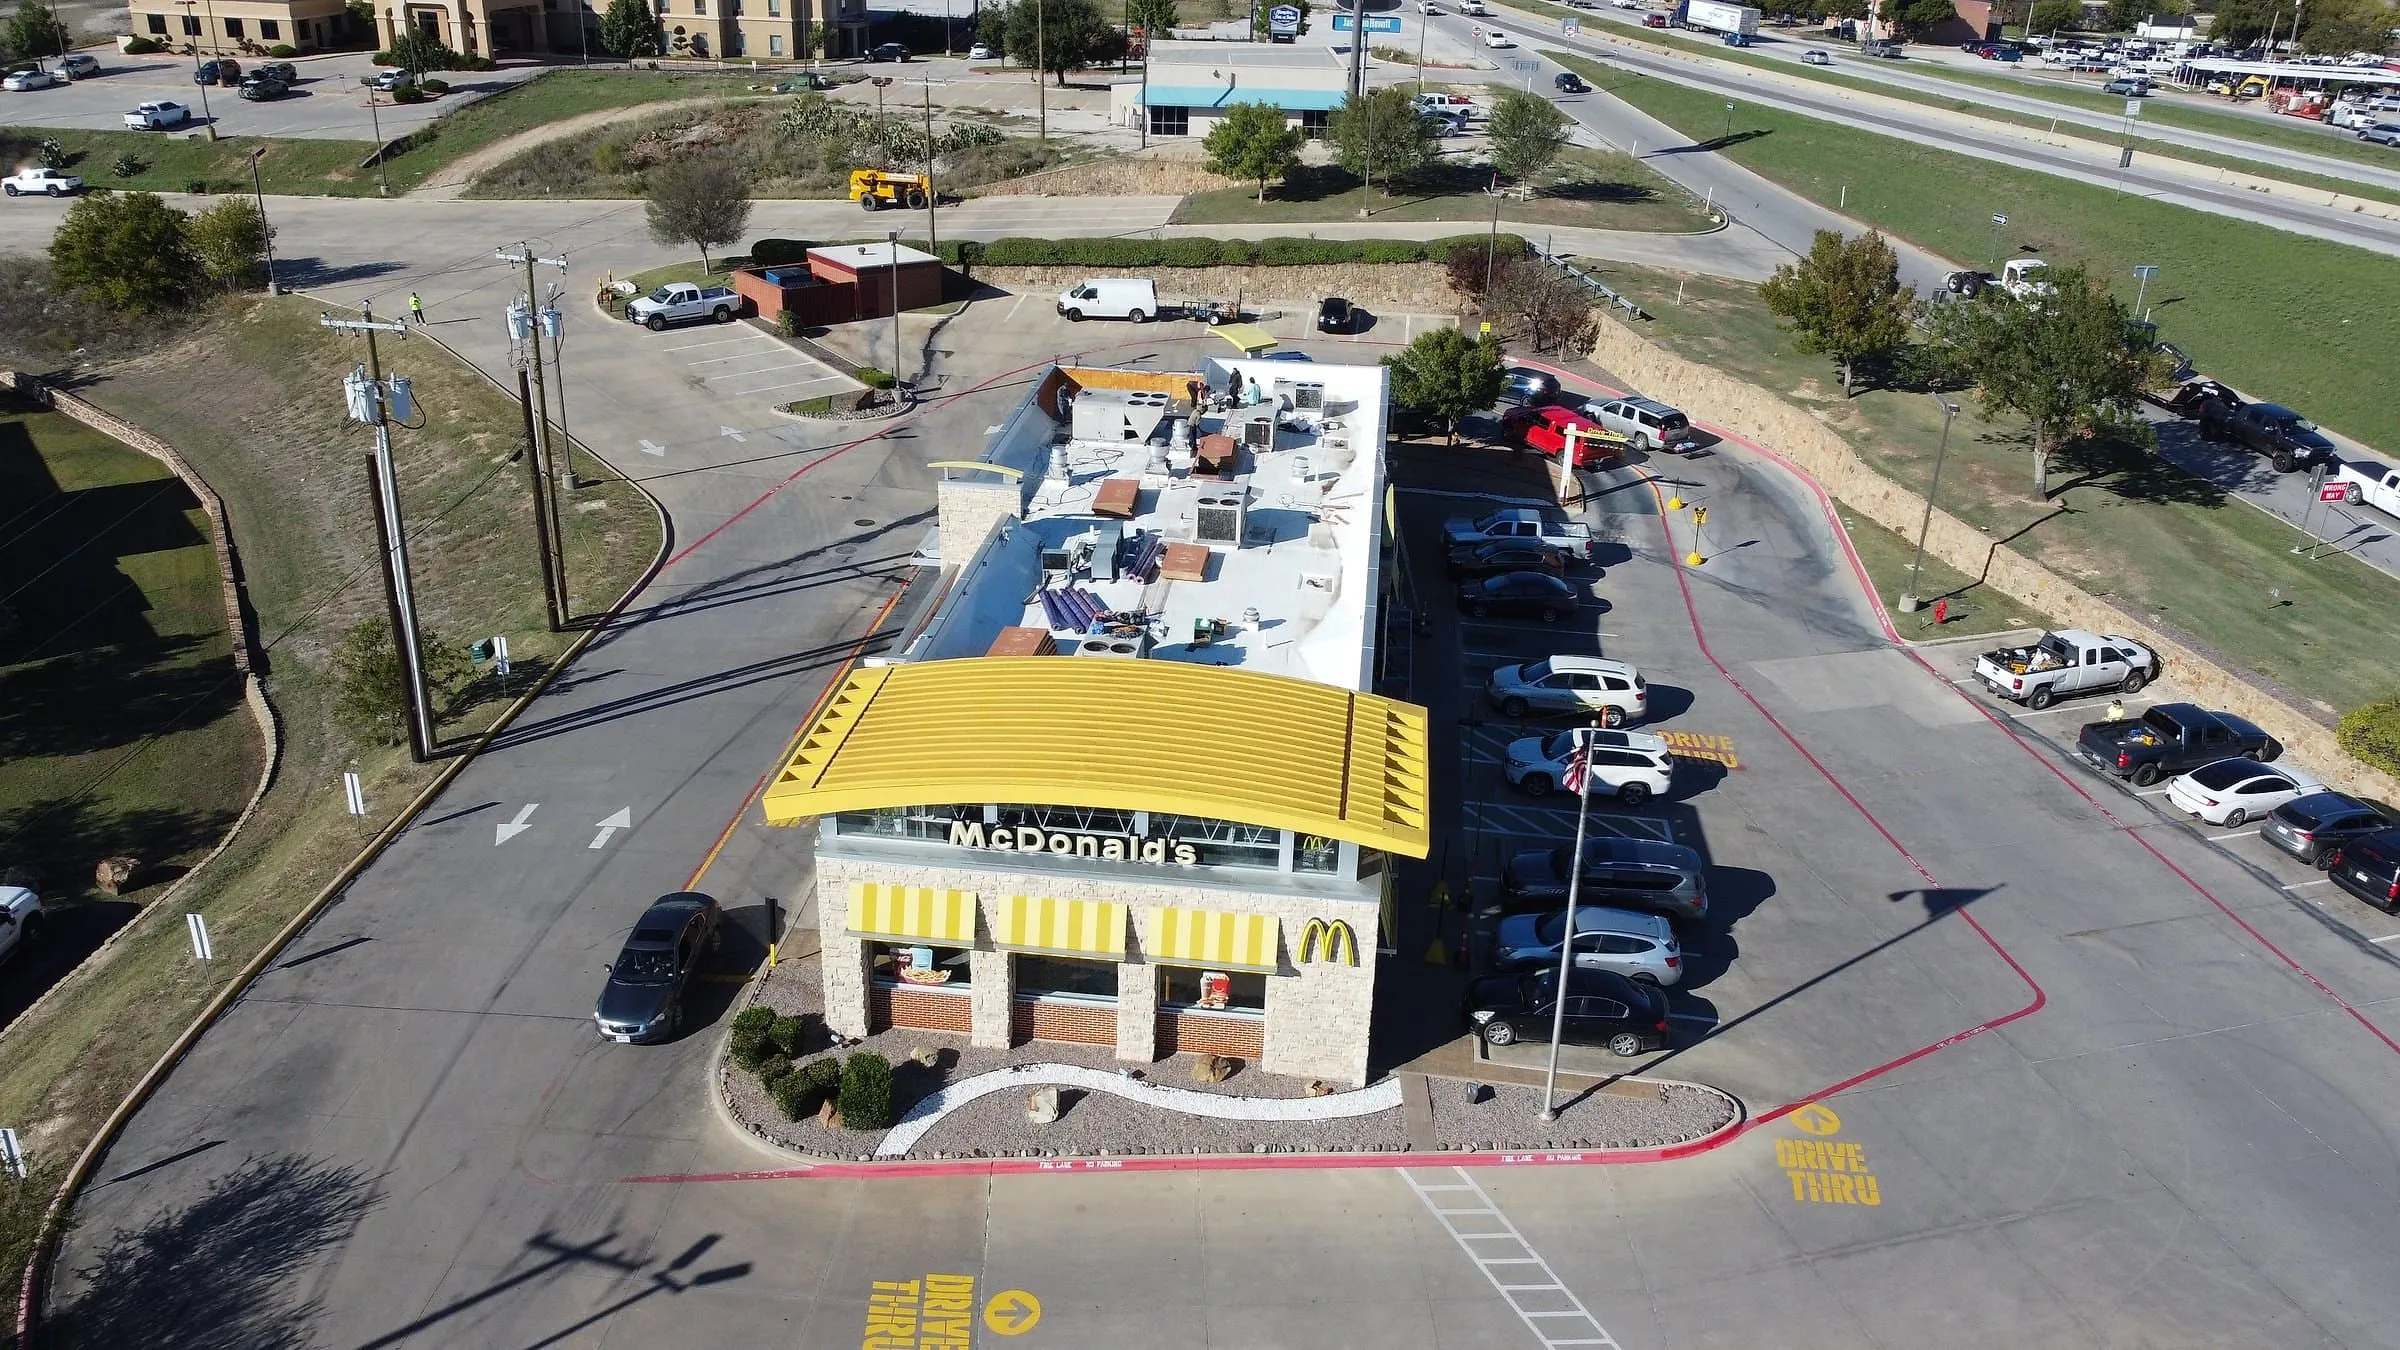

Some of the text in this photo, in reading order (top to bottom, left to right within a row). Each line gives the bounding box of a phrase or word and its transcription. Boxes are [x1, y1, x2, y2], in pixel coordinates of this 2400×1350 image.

[1343, 17, 1369, 28] Jacon
[2324, 484, 2347, 492] WRONG
[2326, 491, 2342, 500] WAY
[949, 819, 1197, 866] McDonald's
[1776, 1139, 1868, 1173] DRIVE
[1787, 1170, 1881, 1206] THRU
[862, 1279, 920, 1350] THRU
[920, 1273, 975, 1350] DRIVE
